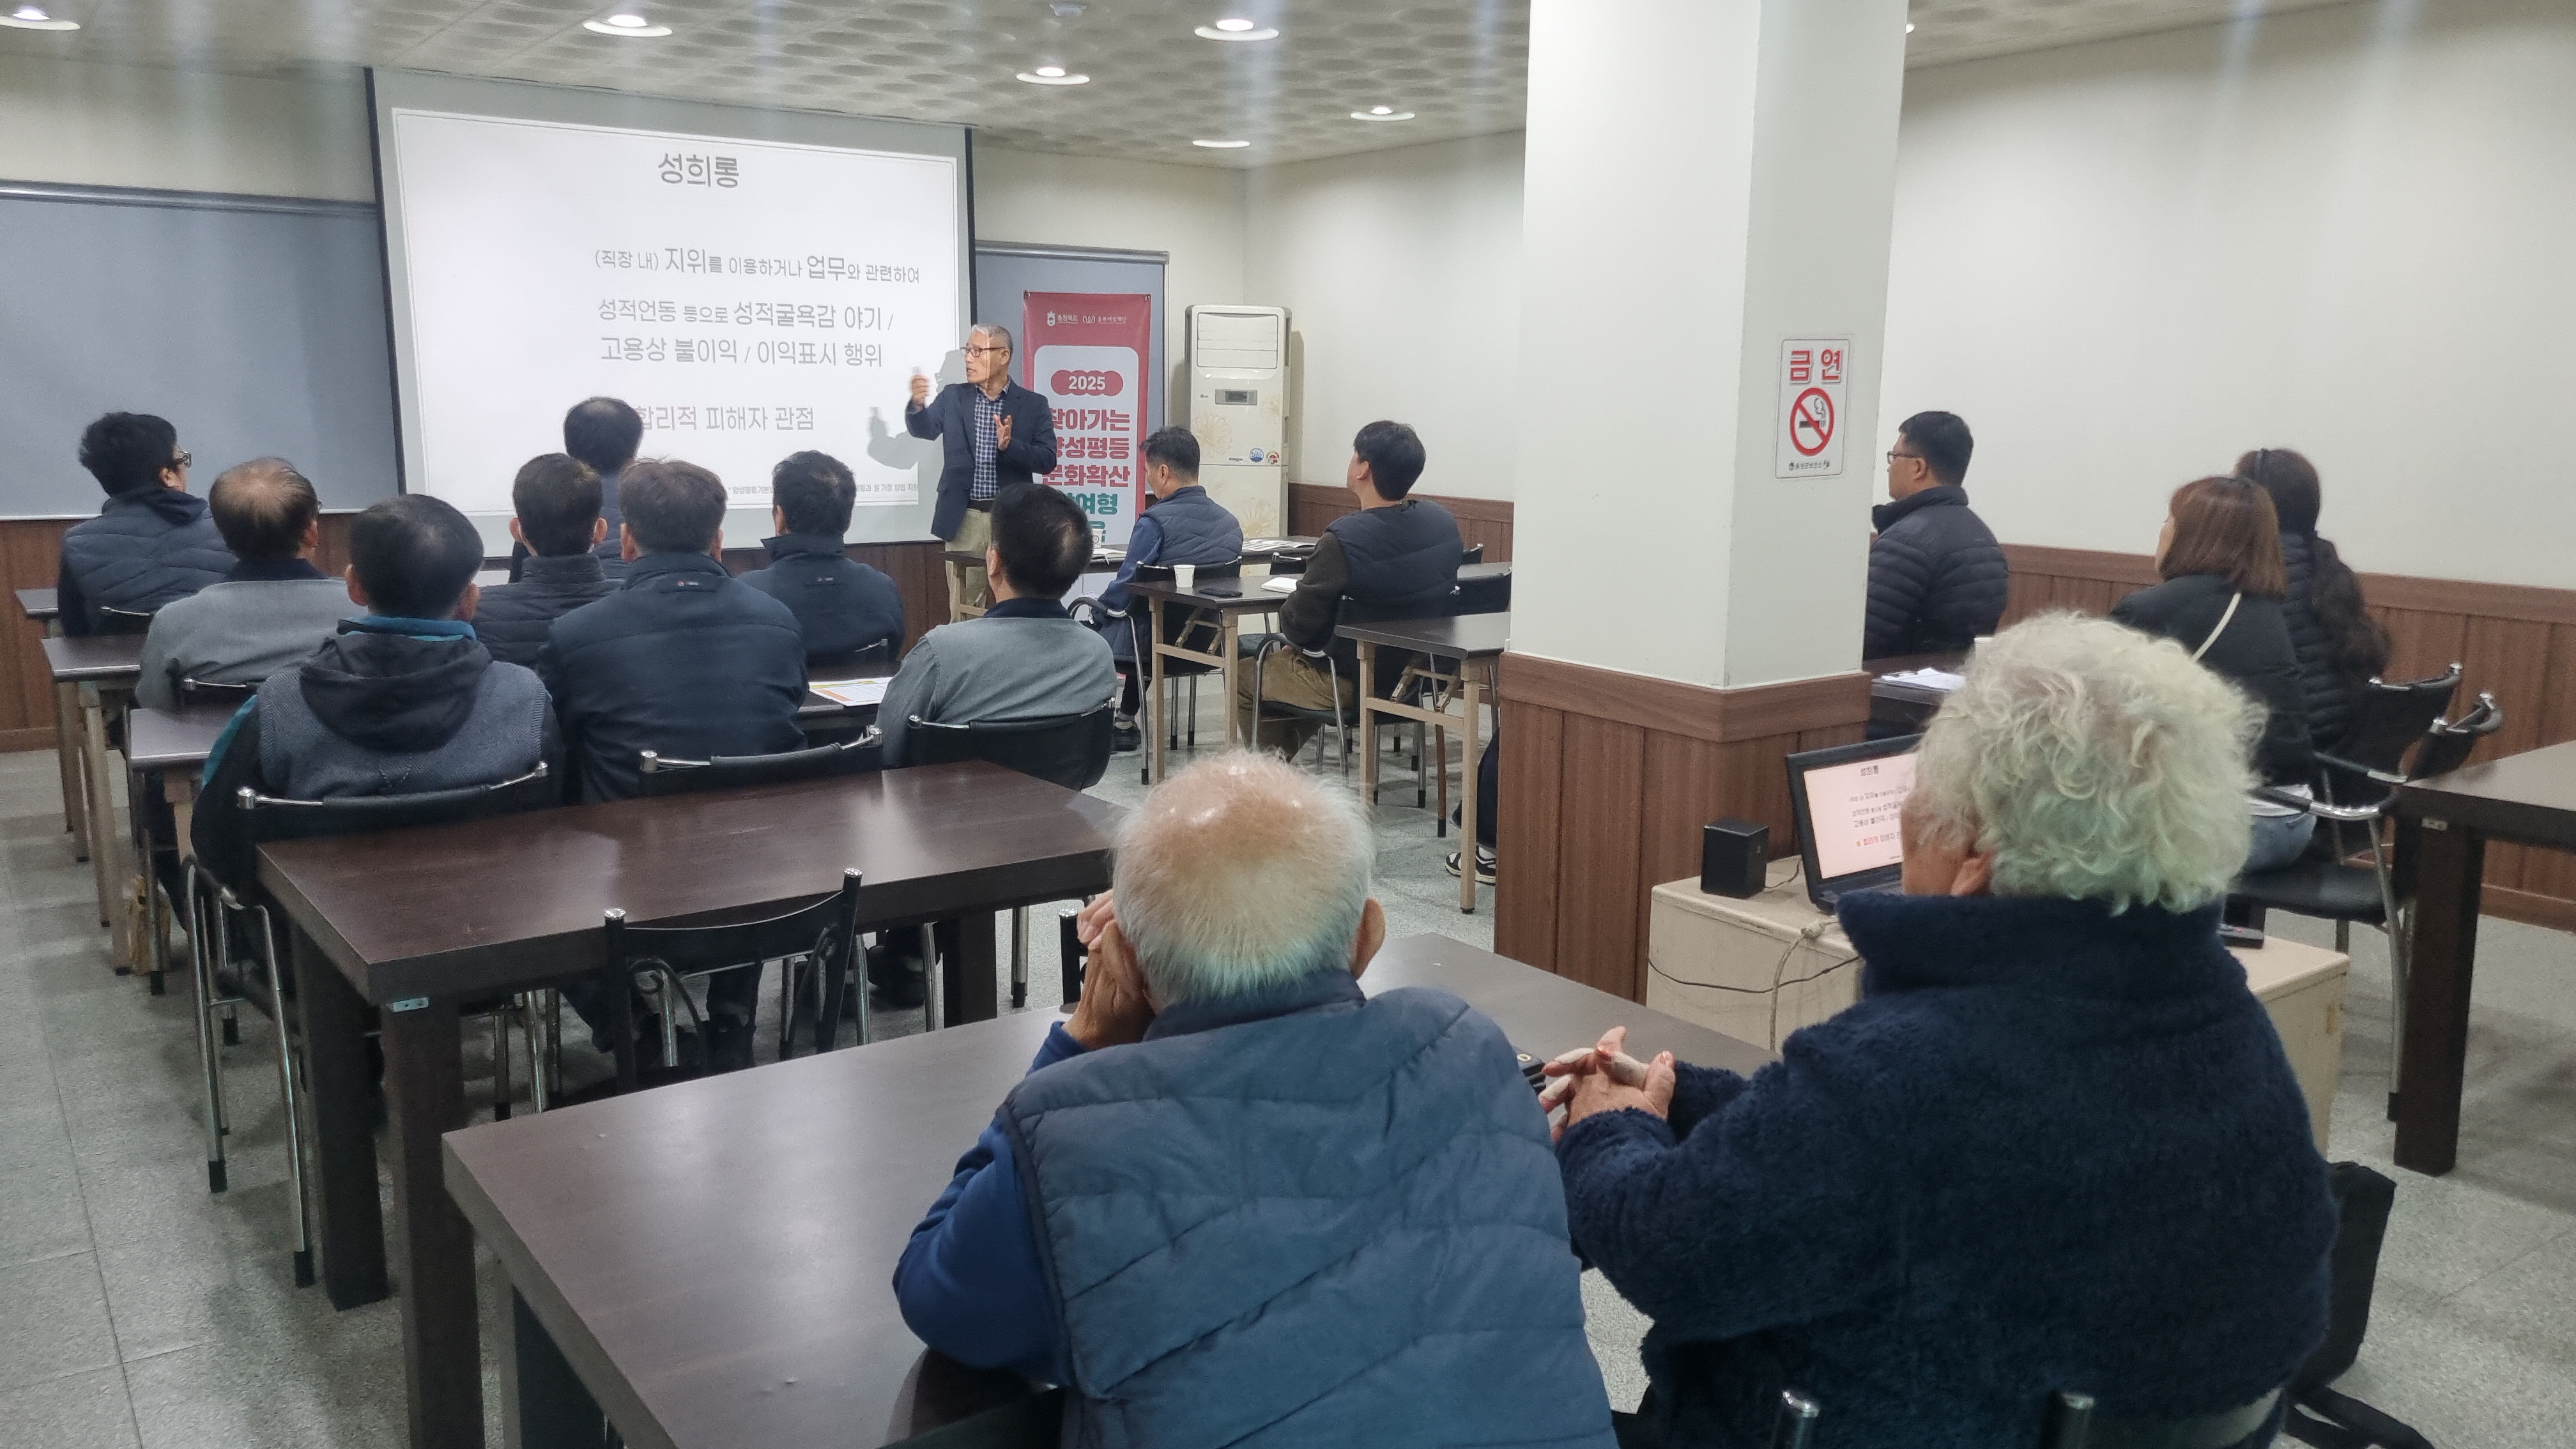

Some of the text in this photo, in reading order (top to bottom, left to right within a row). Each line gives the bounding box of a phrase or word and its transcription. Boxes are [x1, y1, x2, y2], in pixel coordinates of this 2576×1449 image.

[658, 153, 739, 188] 성희롱
[595, 248, 919, 283] (직장 내) 지위를 이용하거나 업무와 관련하여
[598, 298, 677, 322] 성적언동
[684, 306, 728, 323] 등으로
[735, 302, 836, 329] 성적굴욕감
[845, 306, 882, 330] 야기
[601, 337, 667, 362] 고용상
[675, 339, 737, 364] 불이익
[758, 341, 836, 366] 이익표시
[844, 342, 882, 367] 행위
[1068, 376, 1106, 390] 2025
[706, 406, 768, 431] 피해자
[775, 406, 815, 431] 관점
